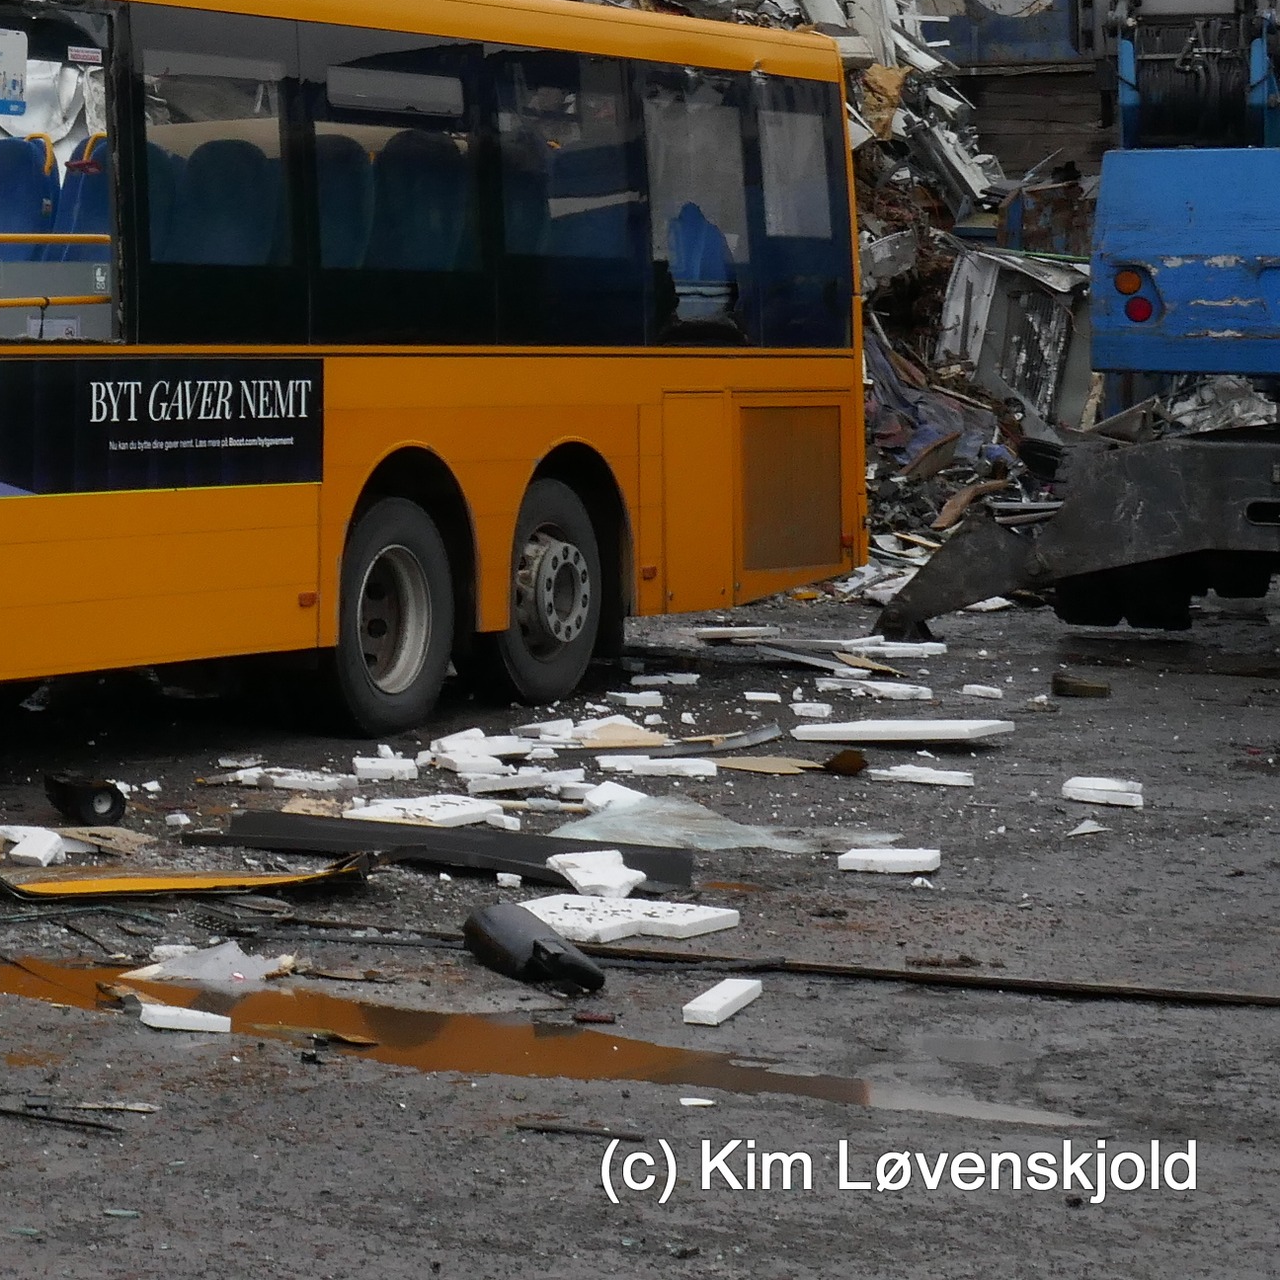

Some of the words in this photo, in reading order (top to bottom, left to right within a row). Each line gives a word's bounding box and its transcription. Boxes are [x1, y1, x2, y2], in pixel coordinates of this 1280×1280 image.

[90, 381, 142, 422] BYT
[148, 380, 233, 422] GAVER
[239, 379, 312, 419] NEMT
